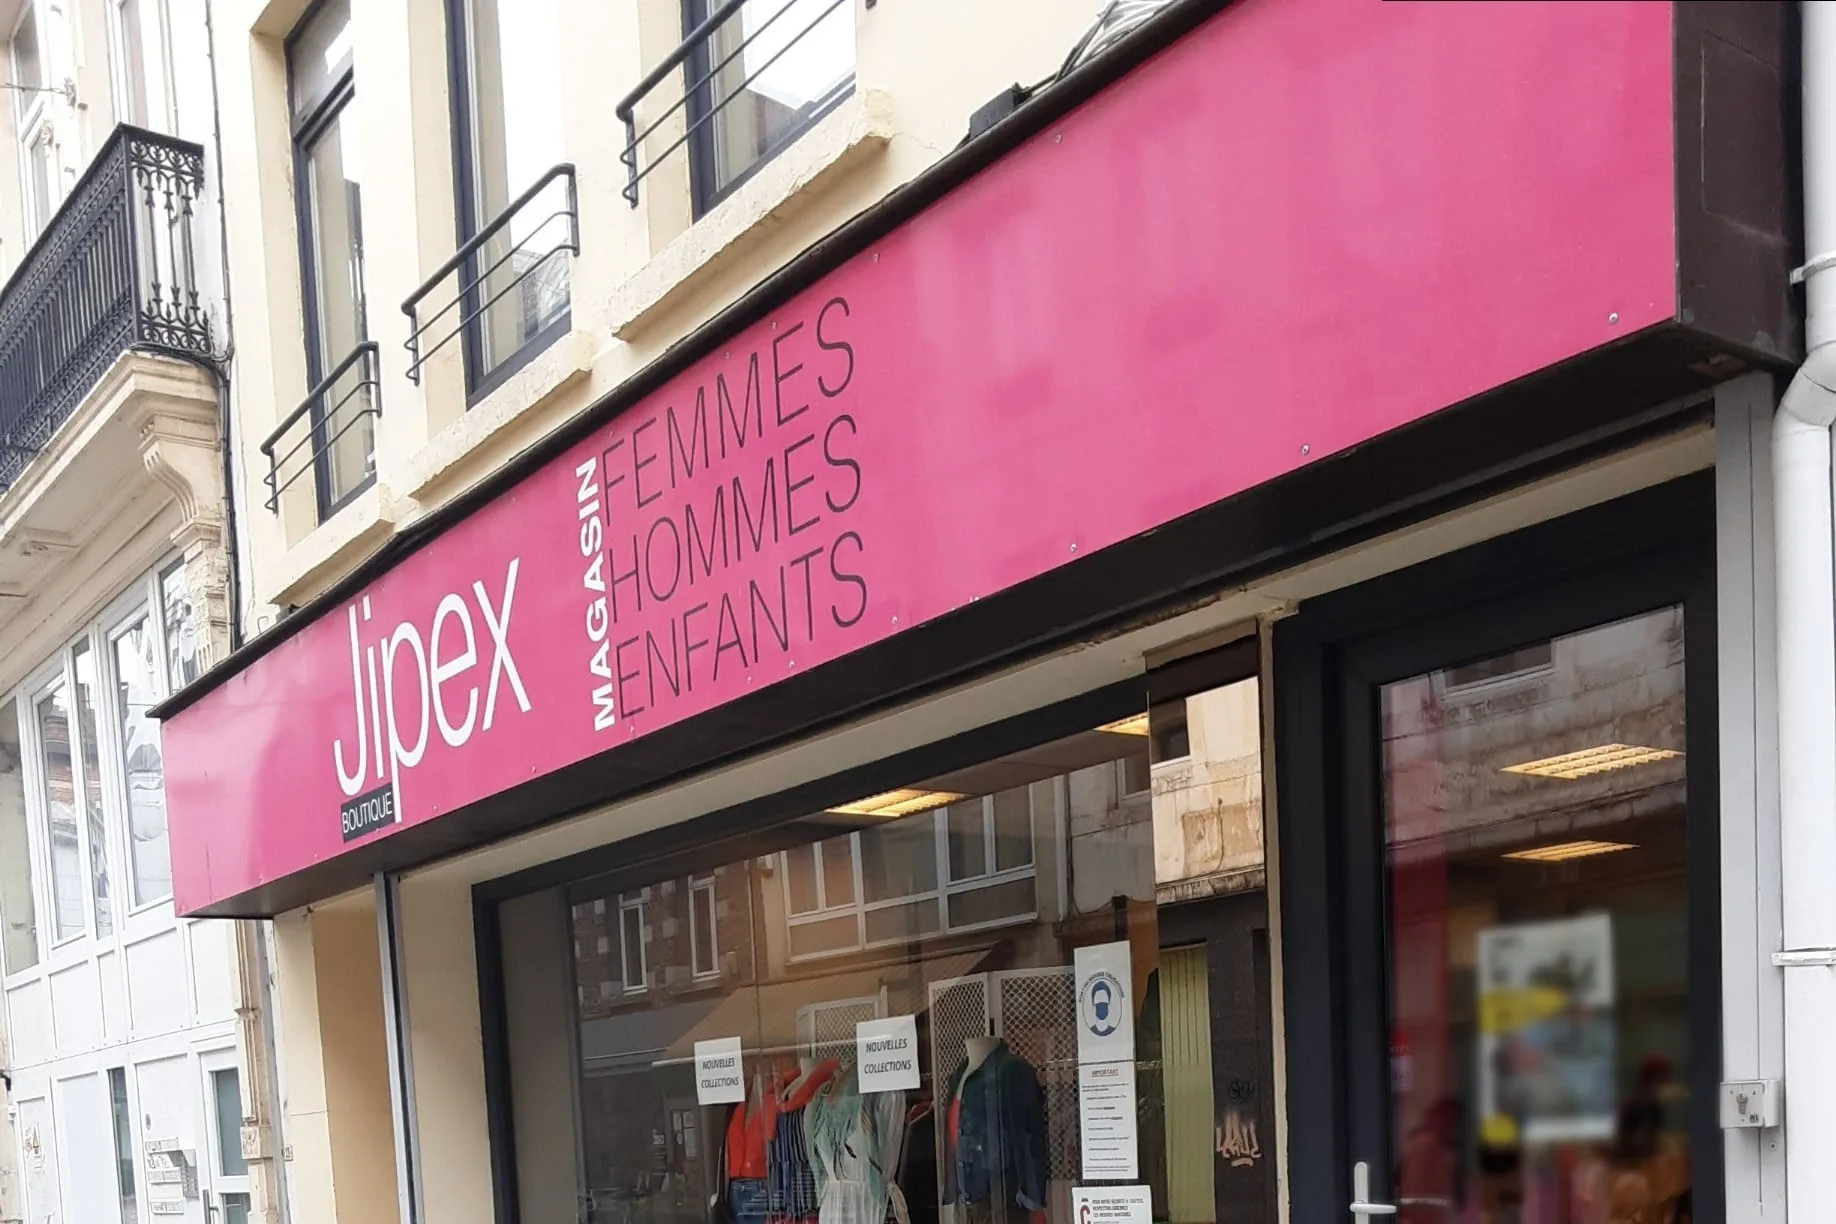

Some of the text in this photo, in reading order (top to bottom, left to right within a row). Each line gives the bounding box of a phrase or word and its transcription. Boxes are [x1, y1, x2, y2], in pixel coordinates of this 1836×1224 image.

[602, 296, 854, 527] FEMMES
[609, 414, 861, 624] HOMMES
[575, 456, 616, 731] MAGASIN
[615, 531, 868, 720] ENFANTS
[334, 556, 533, 823] Jipex
[342, 792, 393, 833] BOUTIQUE
[701, 1076, 740, 1089] COLLECTIONS
[702, 1057, 735, 1070] NOUVELLES
[864, 1059, 912, 1074] COLLECTIONS
[866, 1038, 908, 1053] NOUVELLES
